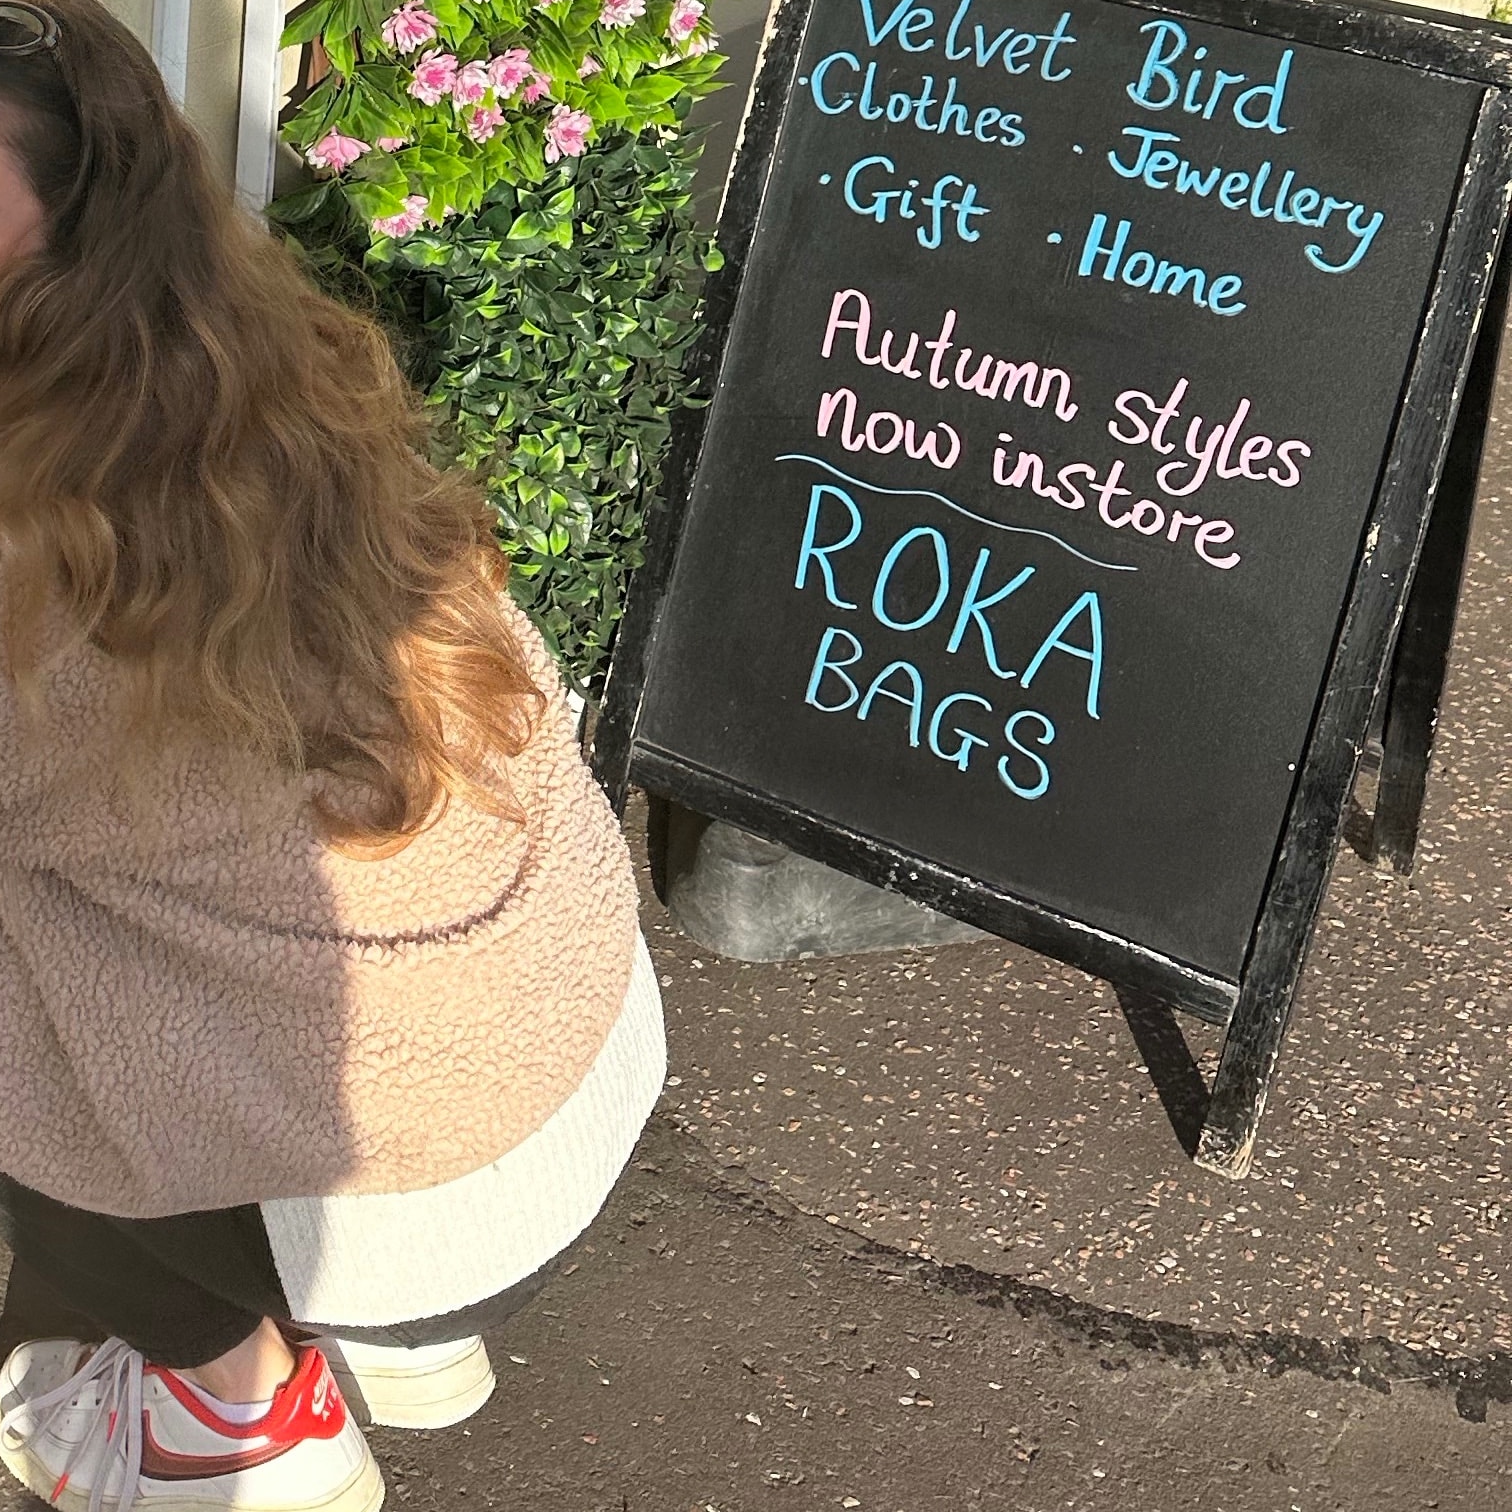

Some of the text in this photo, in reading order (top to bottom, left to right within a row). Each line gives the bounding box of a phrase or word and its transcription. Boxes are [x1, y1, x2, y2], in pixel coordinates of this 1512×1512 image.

[809, 52, 1384, 274] Clothes Jewellery
[1126, 20, 1294, 135] Bird
[843, 155, 1248, 317] Gift Home
[821, 288, 1313, 496] Autumn styles
[992, 432, 1242, 571] instore
[794, 484, 1104, 721] ROKA
[804, 626, 1056, 801] BAGS
